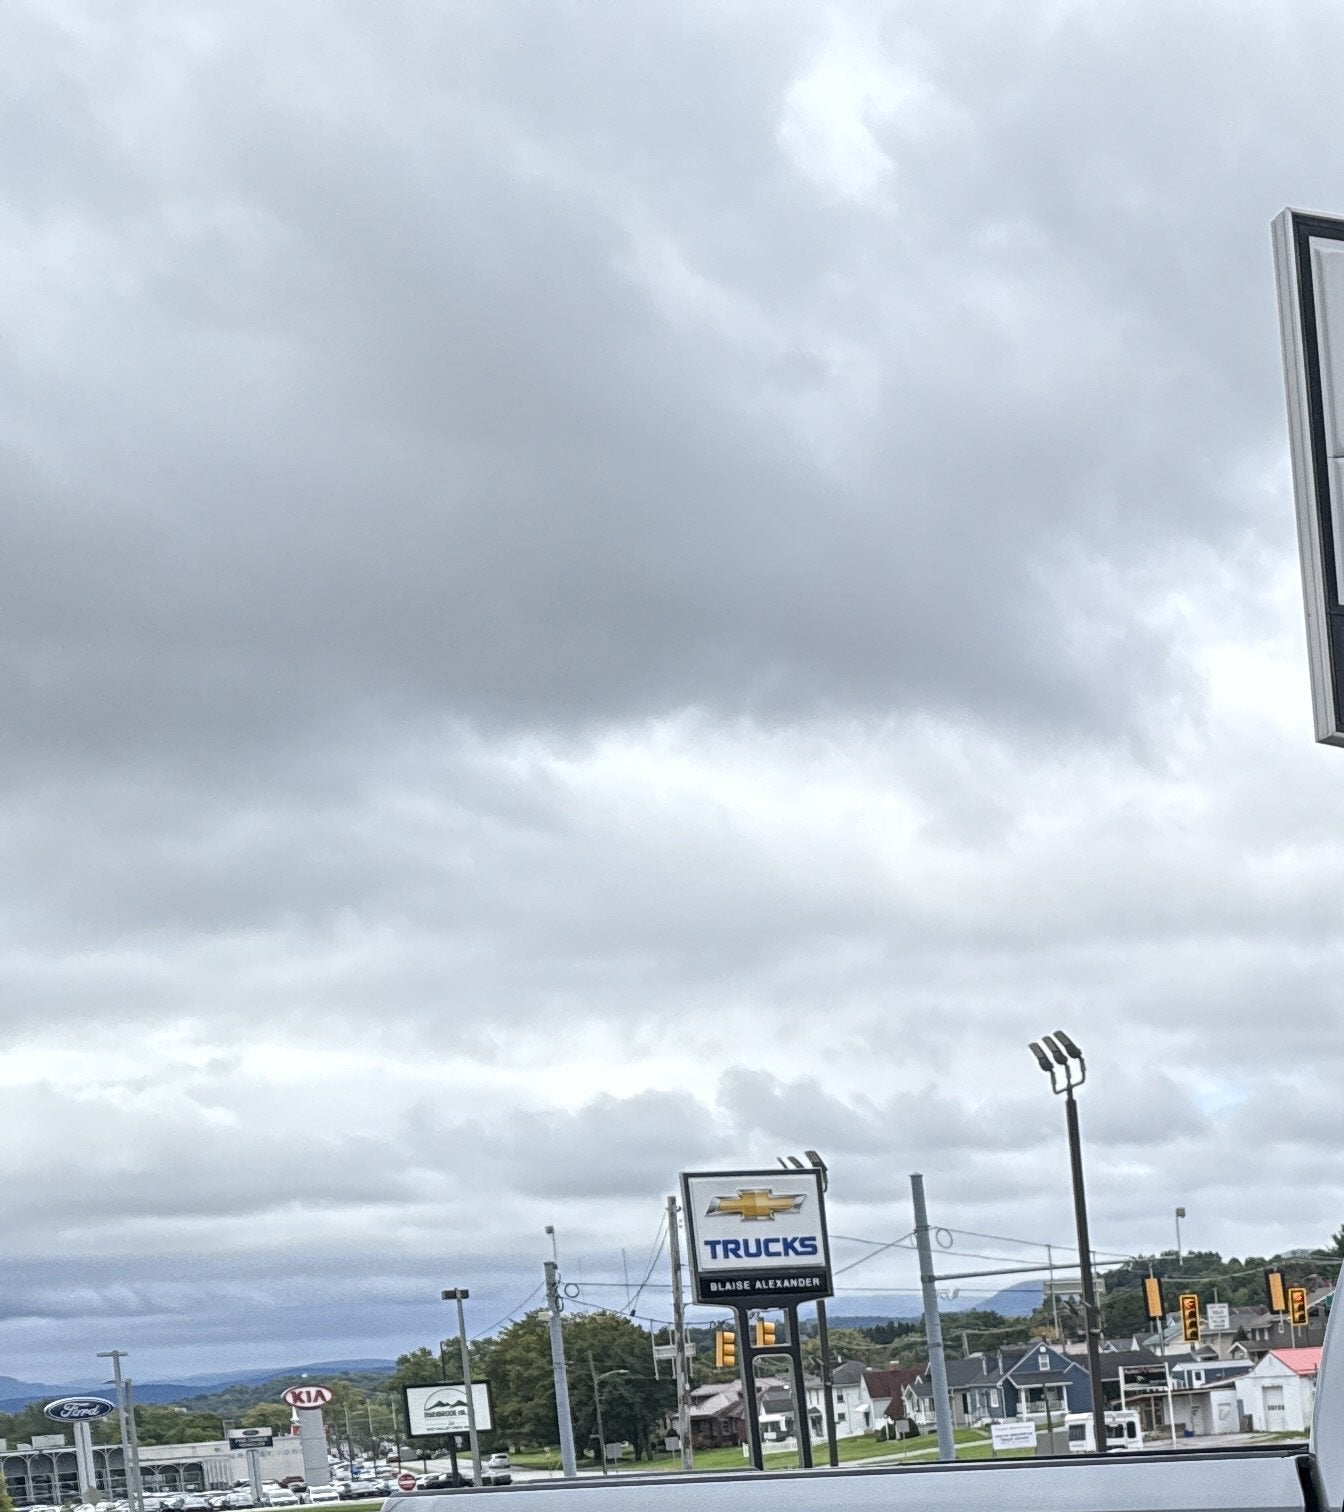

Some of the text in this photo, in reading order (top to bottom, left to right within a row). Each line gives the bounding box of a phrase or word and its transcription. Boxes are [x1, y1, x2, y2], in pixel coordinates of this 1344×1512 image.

[703, 1236, 818, 1260] TRUCKS
[709, 1277, 820, 1292] BLAISE ALEXANDER
[291, 1389, 326, 1404] KIA
[60, 1402, 100, 1418] Ford
